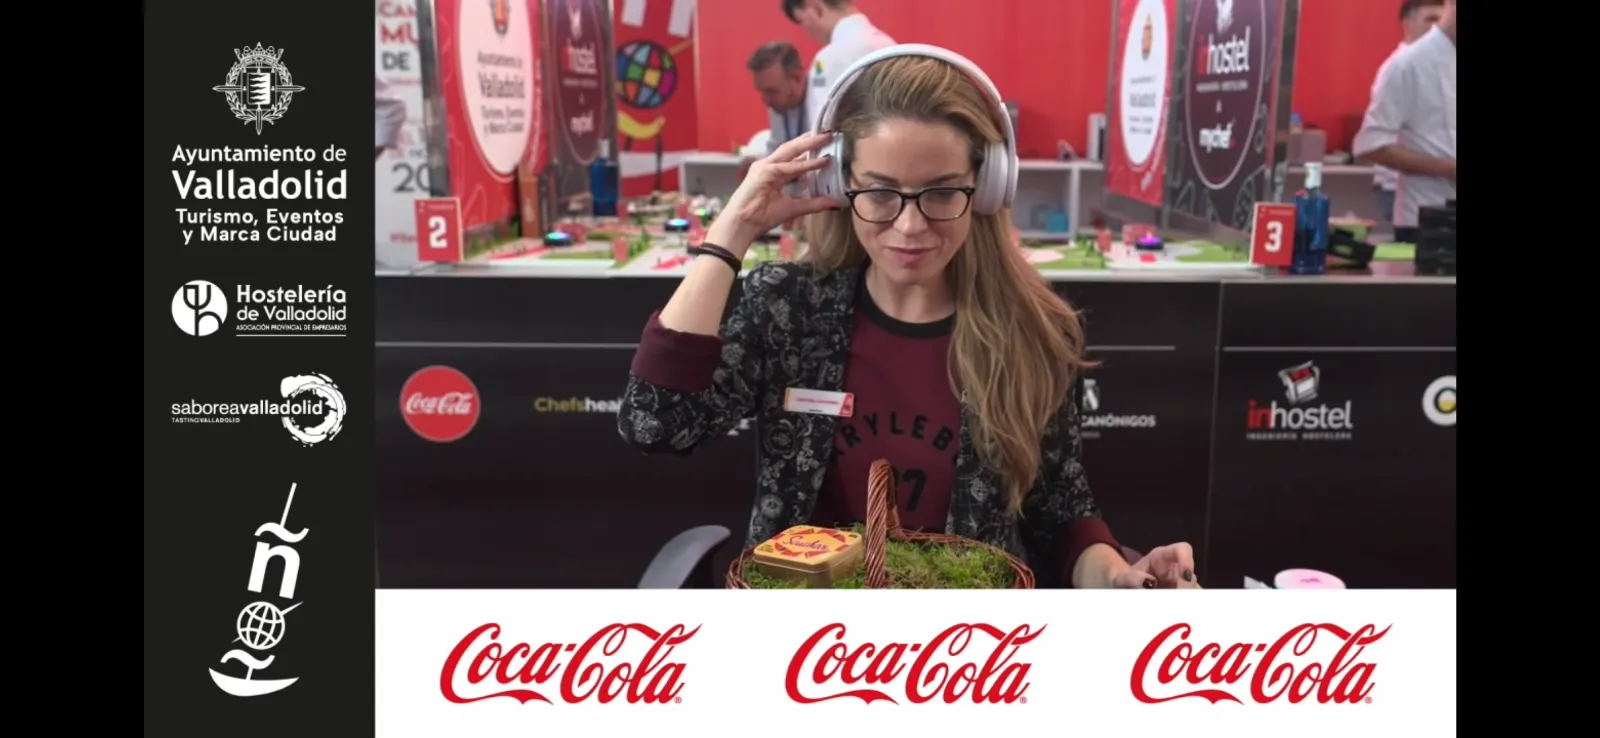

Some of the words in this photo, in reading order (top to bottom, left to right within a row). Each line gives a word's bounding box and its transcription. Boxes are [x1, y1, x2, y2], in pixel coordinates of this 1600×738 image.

[382, 51, 411, 71] DE
[428, 215, 448, 249] 2
[1264, 219, 1284, 253] 3
[1246, 399, 1353, 429] inhostel
